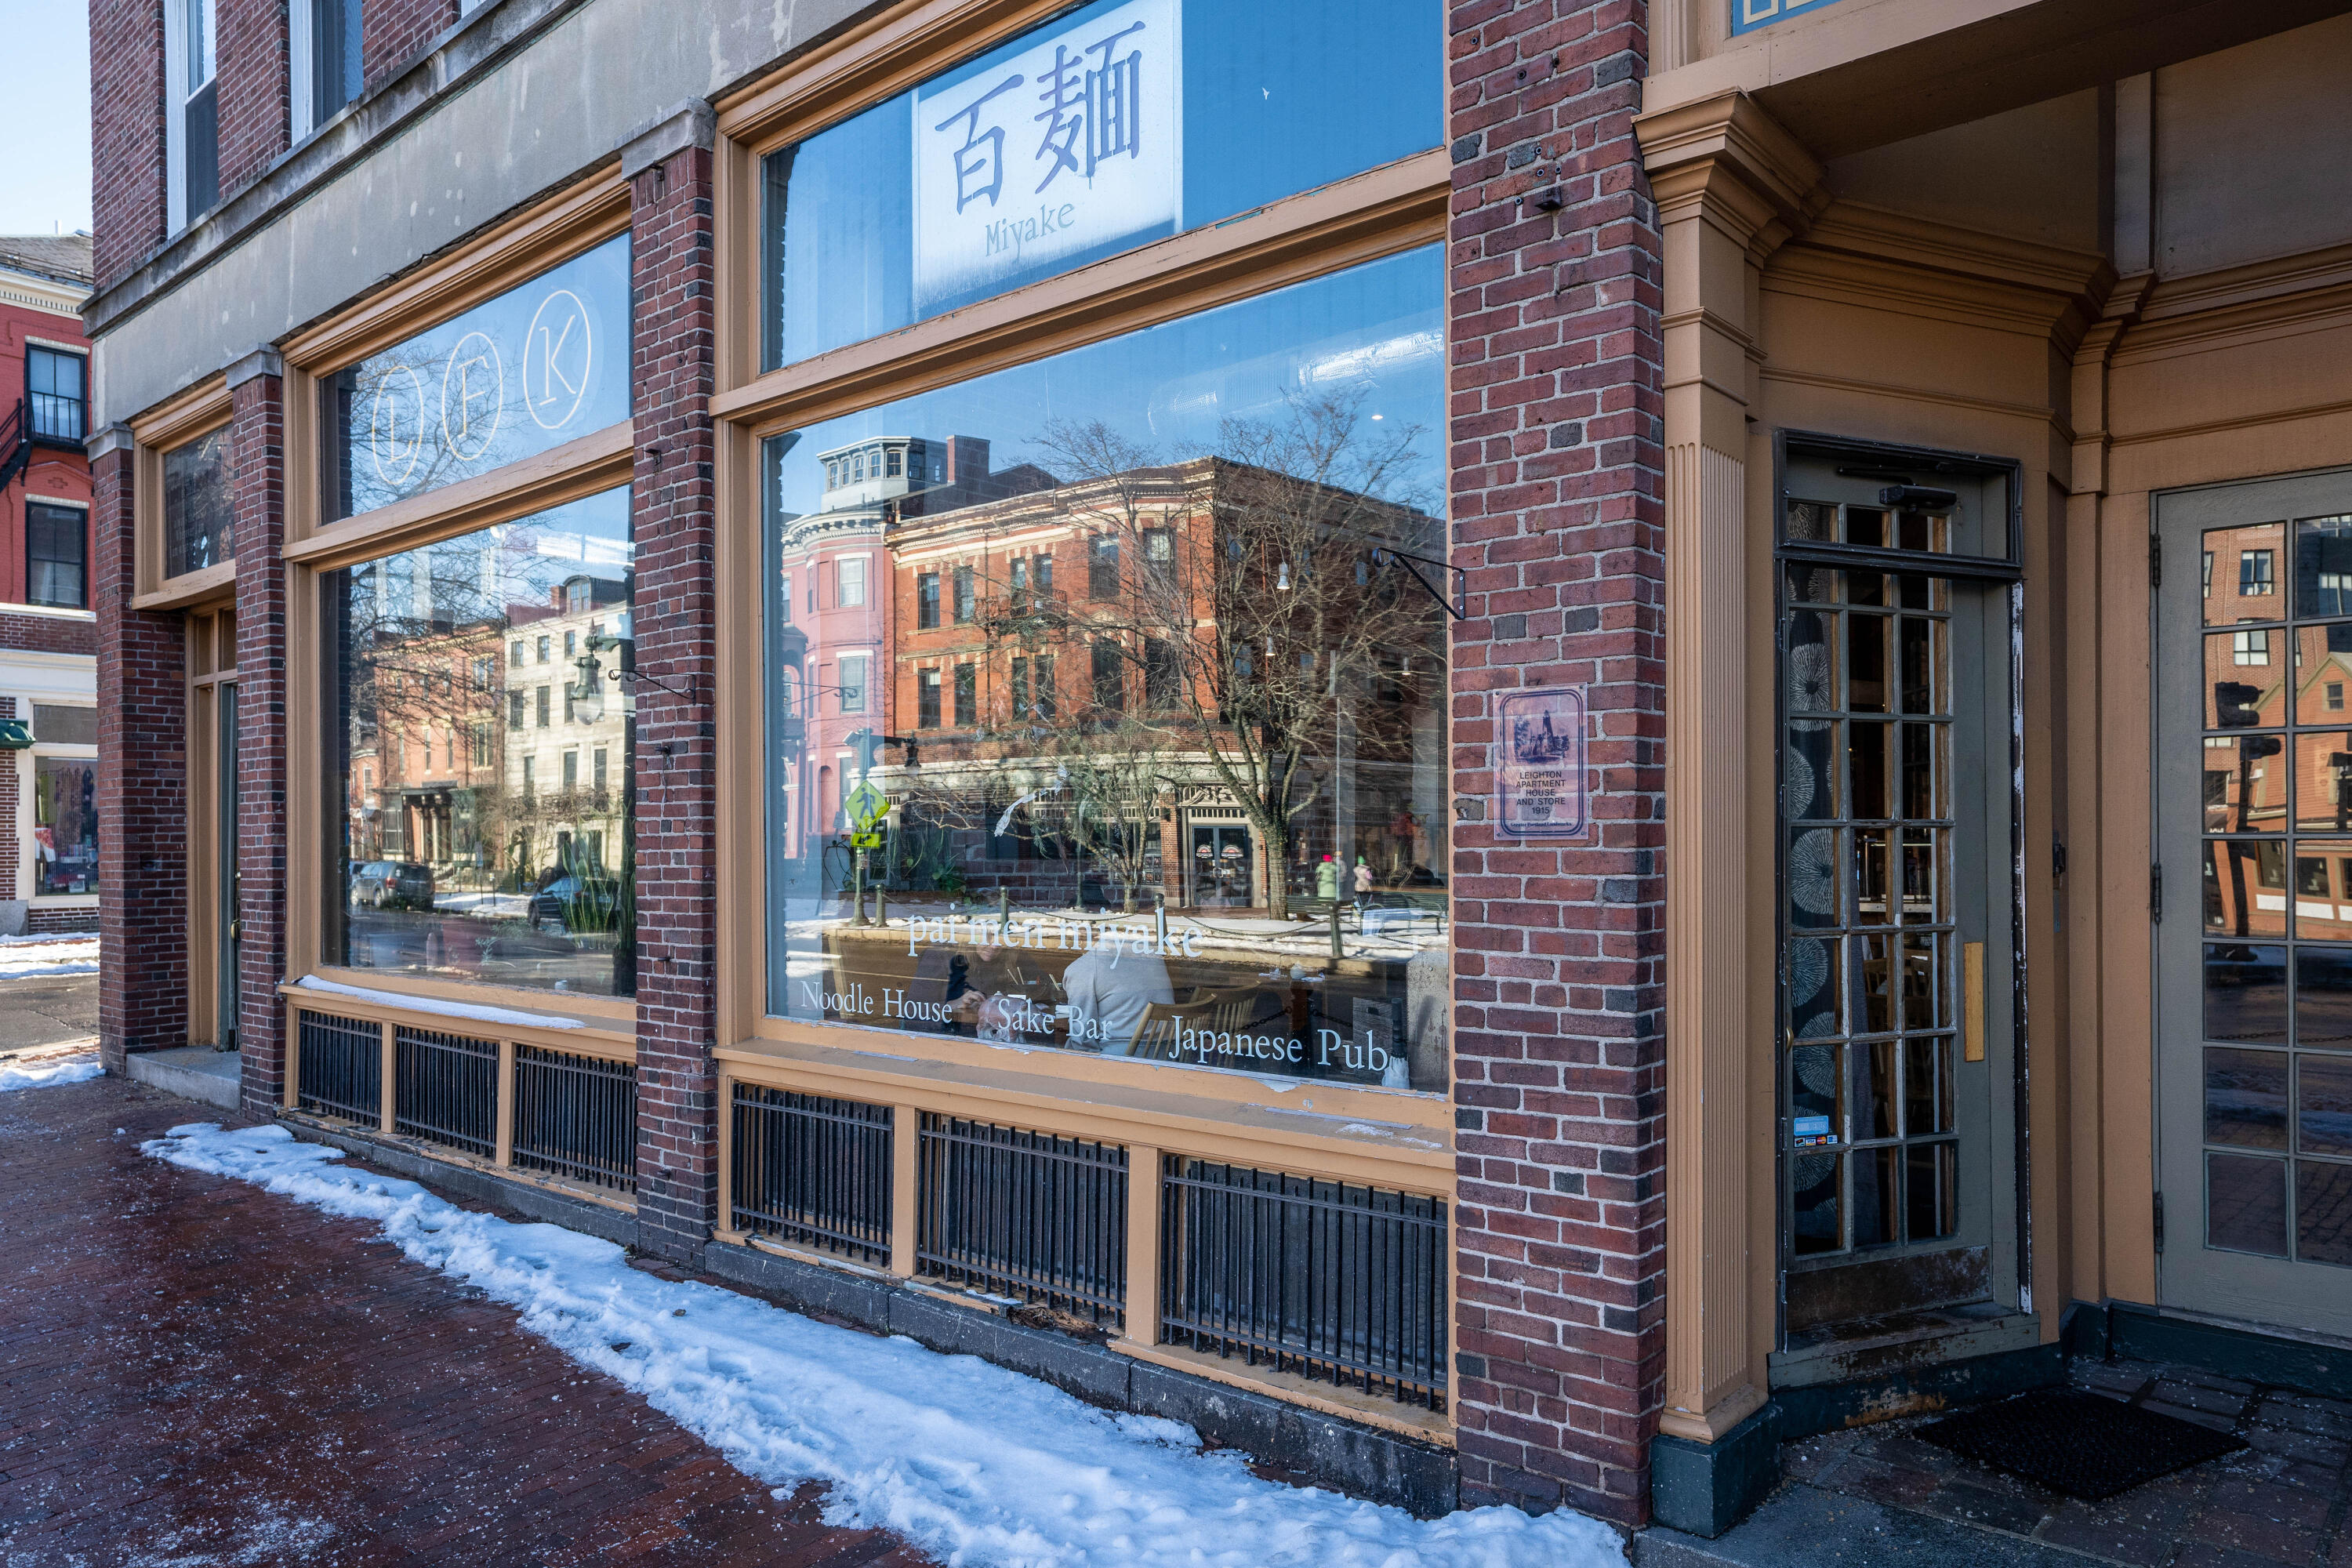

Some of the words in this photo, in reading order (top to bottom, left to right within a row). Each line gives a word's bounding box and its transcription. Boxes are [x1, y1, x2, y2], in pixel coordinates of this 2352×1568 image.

[984, 202, 1076, 259] Miyake
[1515, 779, 1566, 788] APARTMENT
[1519, 771, 1562, 779] LEIGHTON
[907, 902, 957, 957] pai
[967, 917, 1044, 949] men
[1058, 906, 1204, 970] miyake
[800, 981, 874, 1017] Noodle
[883, 989, 953, 1025] House
[996, 993, 1056, 1036] Sake
[1066, 1005, 1113, 1043] Bar
[1168, 1014, 1305, 1065] Japanese
[1316, 1029, 1390, 1073] Pub
